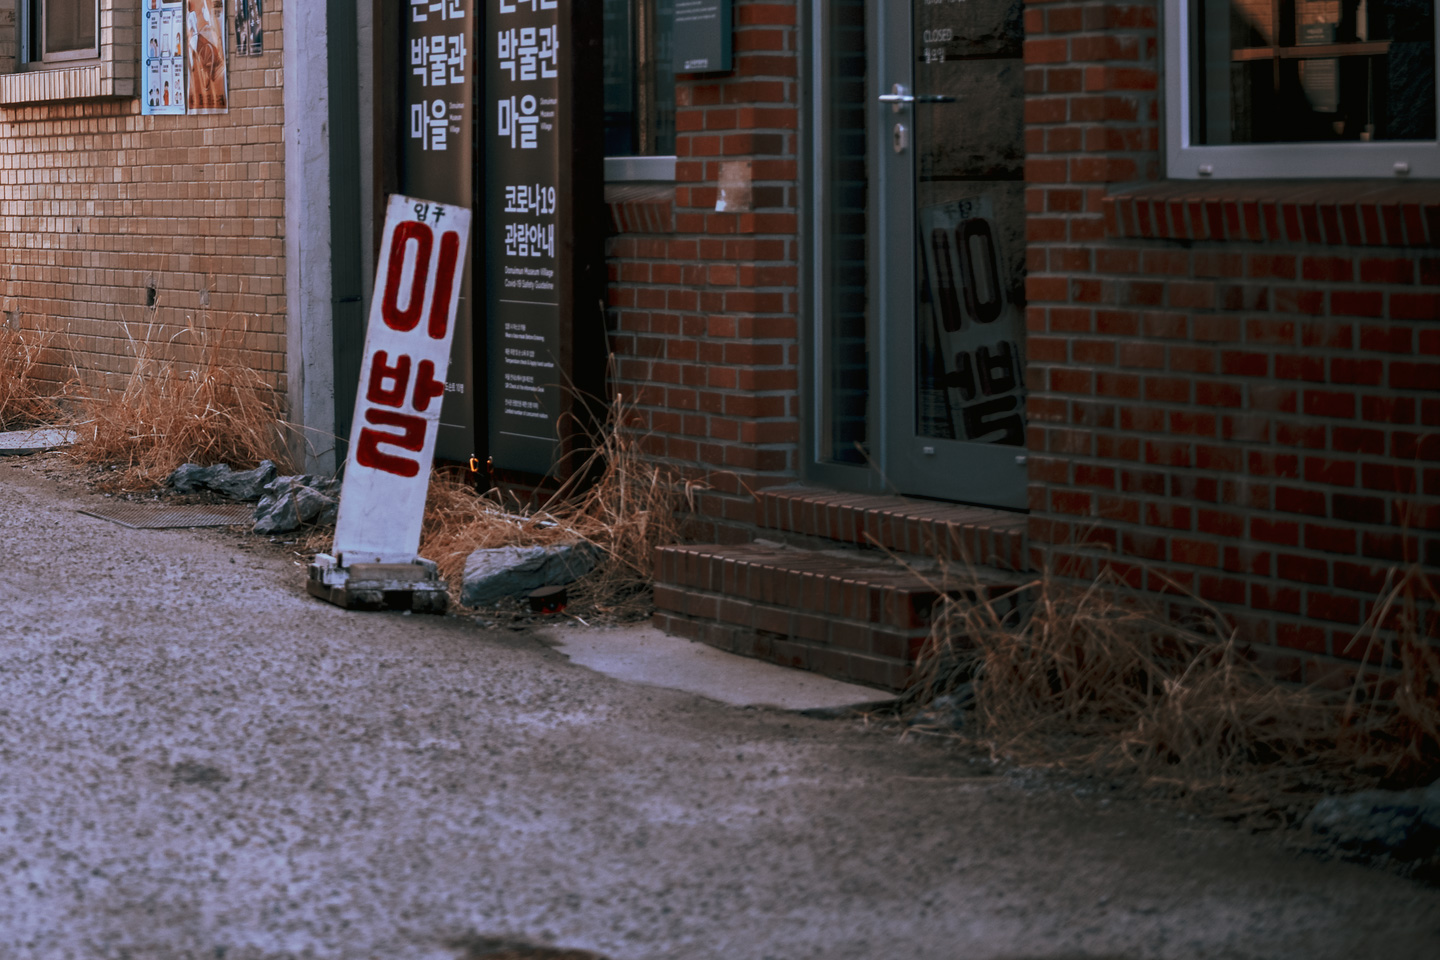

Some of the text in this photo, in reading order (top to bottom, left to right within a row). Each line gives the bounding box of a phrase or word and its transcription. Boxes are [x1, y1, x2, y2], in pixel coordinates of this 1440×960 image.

[497, 24, 559, 82] 박물관
[923, 28, 953, 43] CLOSED
[924, 47, 945, 64] 월요일
[411, 33, 467, 87] 박물관
[411, 99, 448, 150] 마을
[497, 94, 539, 149] 마을
[413, 203, 446, 223] 입구
[504, 183, 556, 216] 코로나19
[504, 222, 555, 259] 관람안내
[356, 220, 460, 479] 이발
